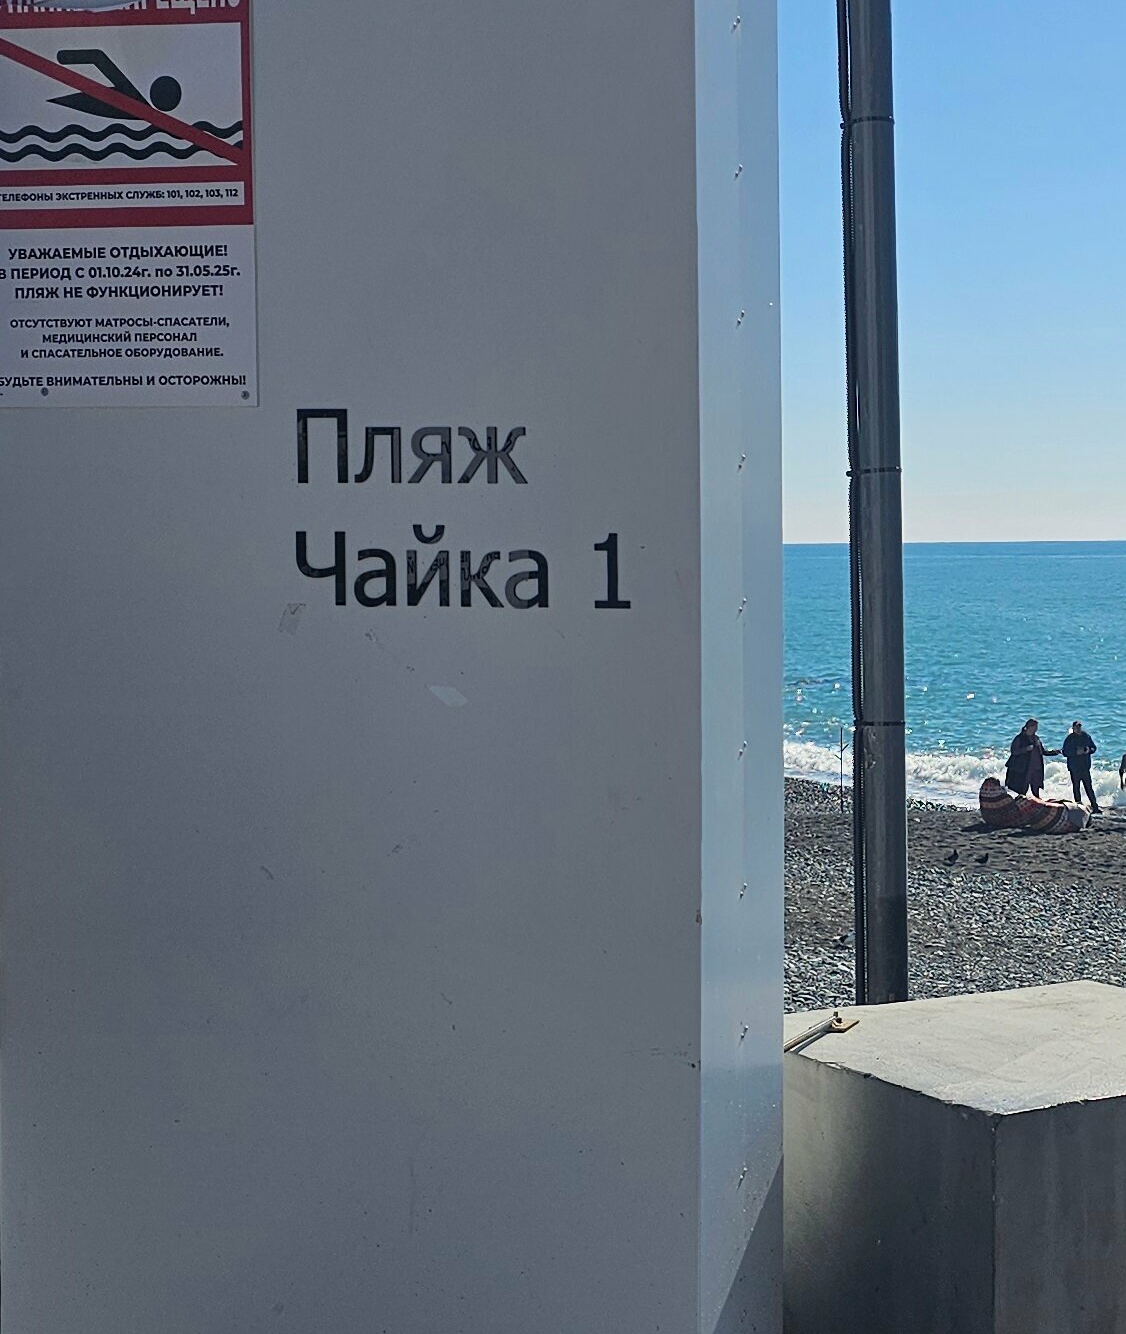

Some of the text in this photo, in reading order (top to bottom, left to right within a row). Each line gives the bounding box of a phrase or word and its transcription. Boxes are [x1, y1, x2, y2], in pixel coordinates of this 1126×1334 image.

[0, 188, 238, 202] ЕЛЕФОНЫ ЭКСТРЕННЫХ СЛУЖБ: 101, 102, 103, 112
[8, 245, 228, 260] УВАЖАЕМЫЕ ОТДЫХАЮЩИЕ!
[11, 267, 71, 280] ПЕРИОД
[75, 267, 85, 279] С
[88, 266, 151, 279] 01.10.24г.
[155, 268, 173, 278] по
[176, 265, 241, 277] 31.05.25г.
[15, 285, 224, 299] ПЛЯЖ НЕ ФУНКЦИОНИРУЕТ!
[10, 317, 230, 328] ОТСУТСТВУЮТ МАТРОСЫ-СПАСАТЕЛИ,
[42, 331, 198, 344] МЕДИЦИНСКИЙ ПЕРСОНАЛ
[20, 347, 224, 358] И СПАСАТЕЛЬНОЕ ОБОРУДОВАНИЕ.
[46, 375, 143, 386] ВНИМАТЕЛЬНЫ
[146, 375, 156, 385] И
[158, 374, 247, 385] ОСТОРОЖНЫ!
[296, 408, 529, 484] Пляж
[295, 524, 631, 609] Чайка 1
